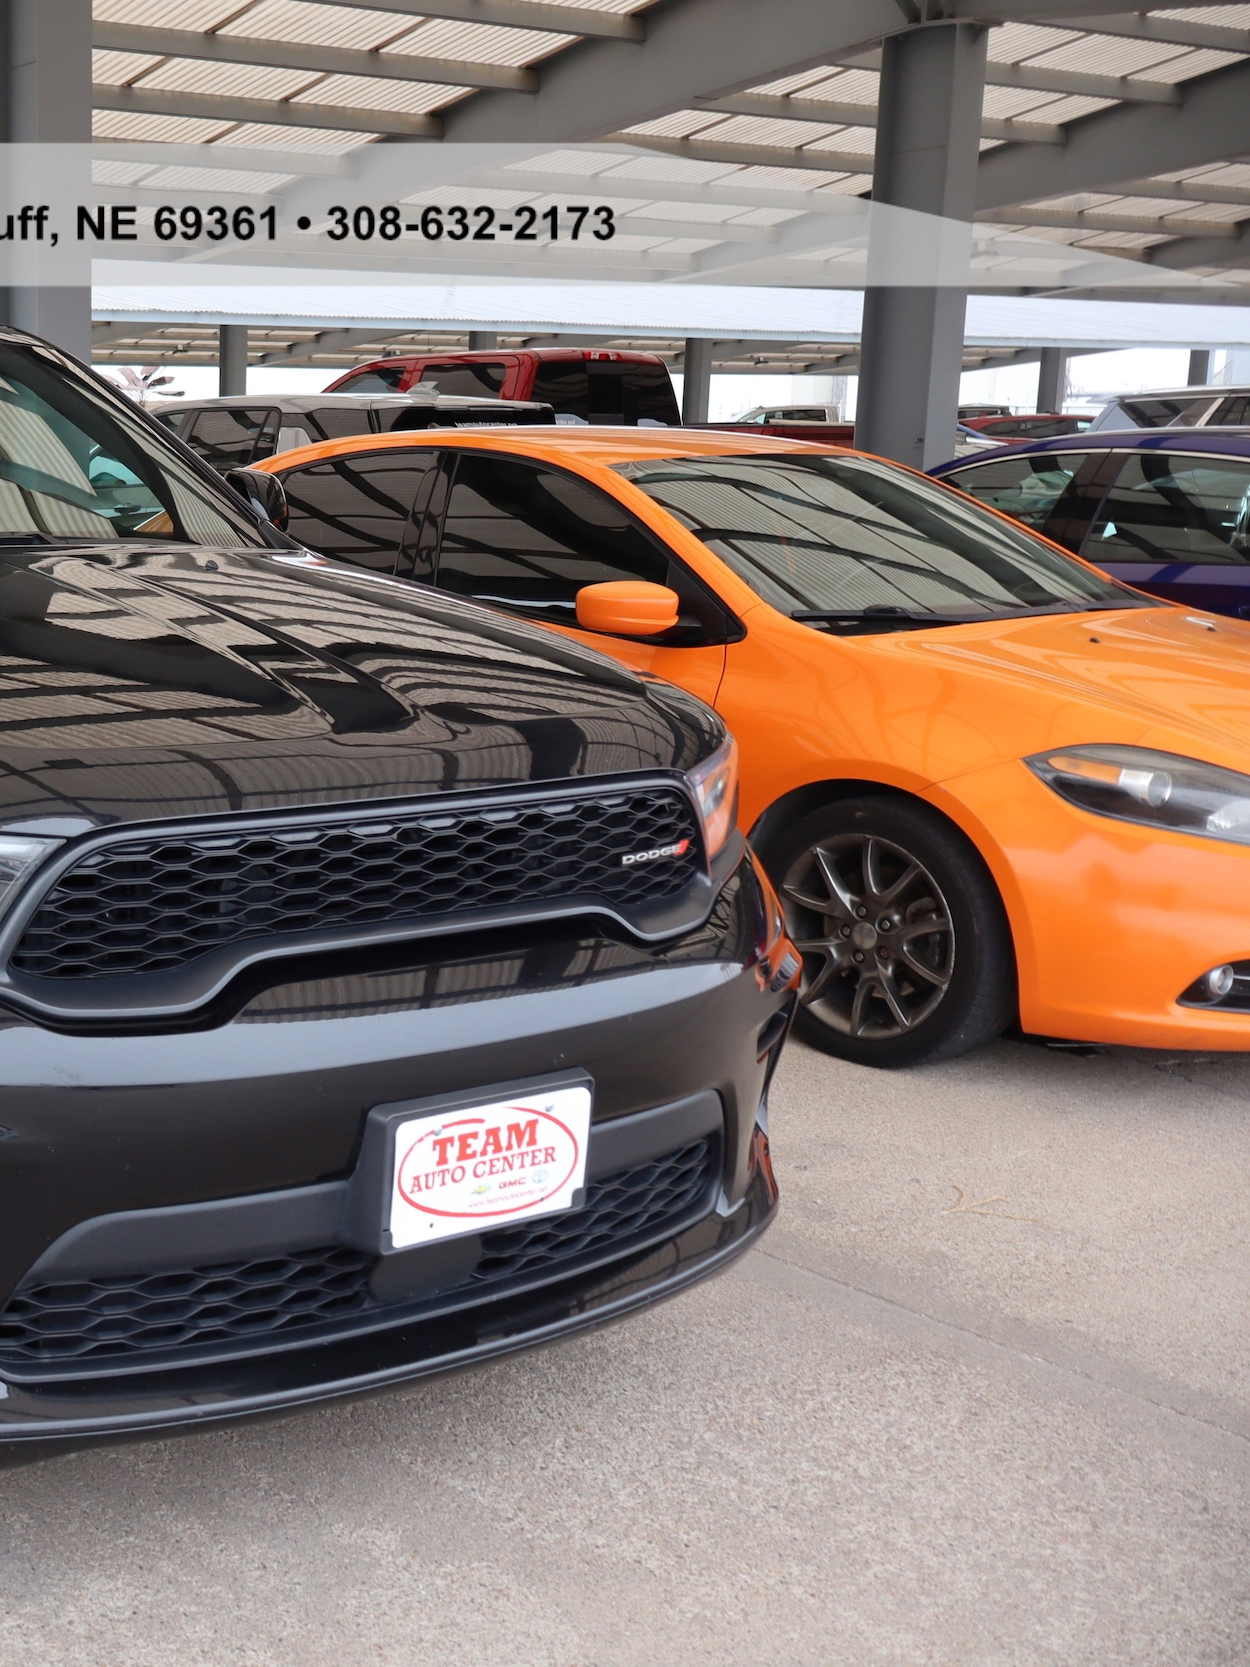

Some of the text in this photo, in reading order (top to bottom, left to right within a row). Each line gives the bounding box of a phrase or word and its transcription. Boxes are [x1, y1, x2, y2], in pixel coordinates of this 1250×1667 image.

[622, 844, 681, 865] DODGE
[432, 1118, 540, 1167] TEAM
[409, 1146, 557, 1195] AUTO CENTER
[498, 1177, 527, 1190] GMC
